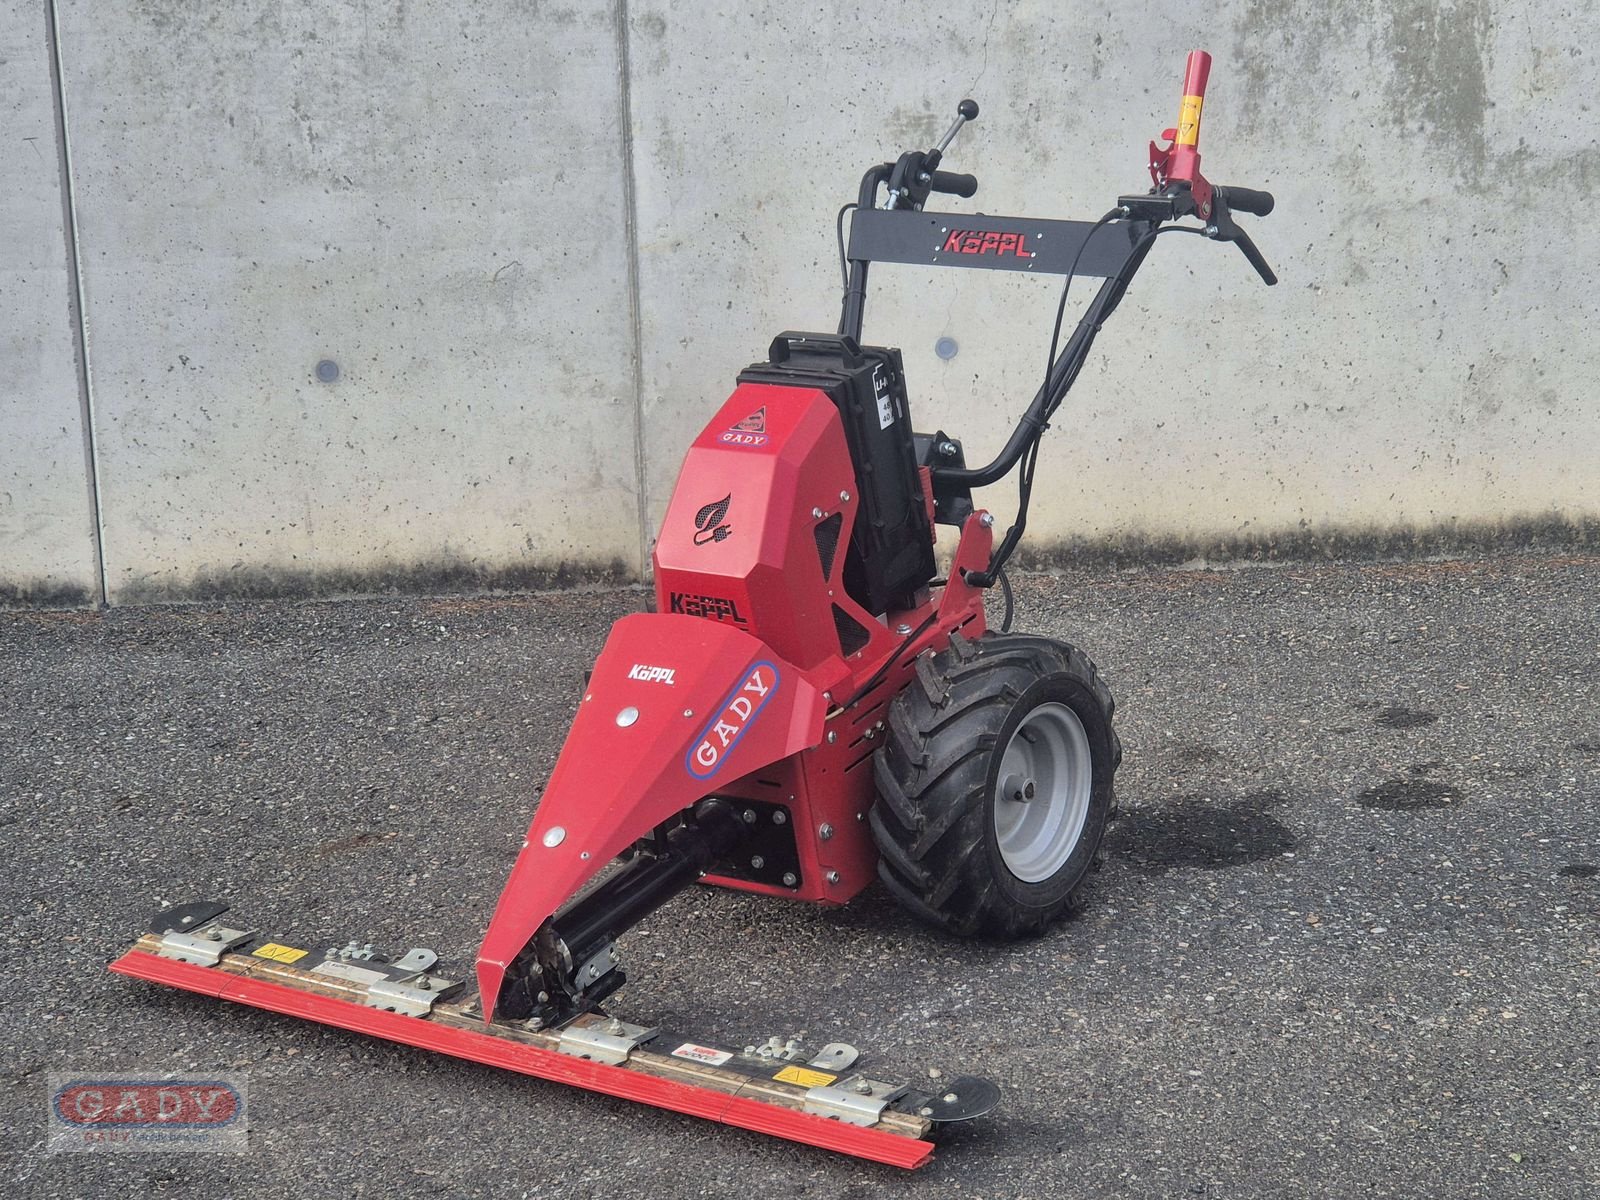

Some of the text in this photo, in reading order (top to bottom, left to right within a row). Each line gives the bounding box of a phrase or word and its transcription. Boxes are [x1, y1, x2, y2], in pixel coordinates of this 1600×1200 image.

[943, 229, 1030, 257] KÖPPL
[723, 433, 764, 445] GADY
[670, 592, 748, 623] KÖPPL
[697, 670, 768, 767] GADY
